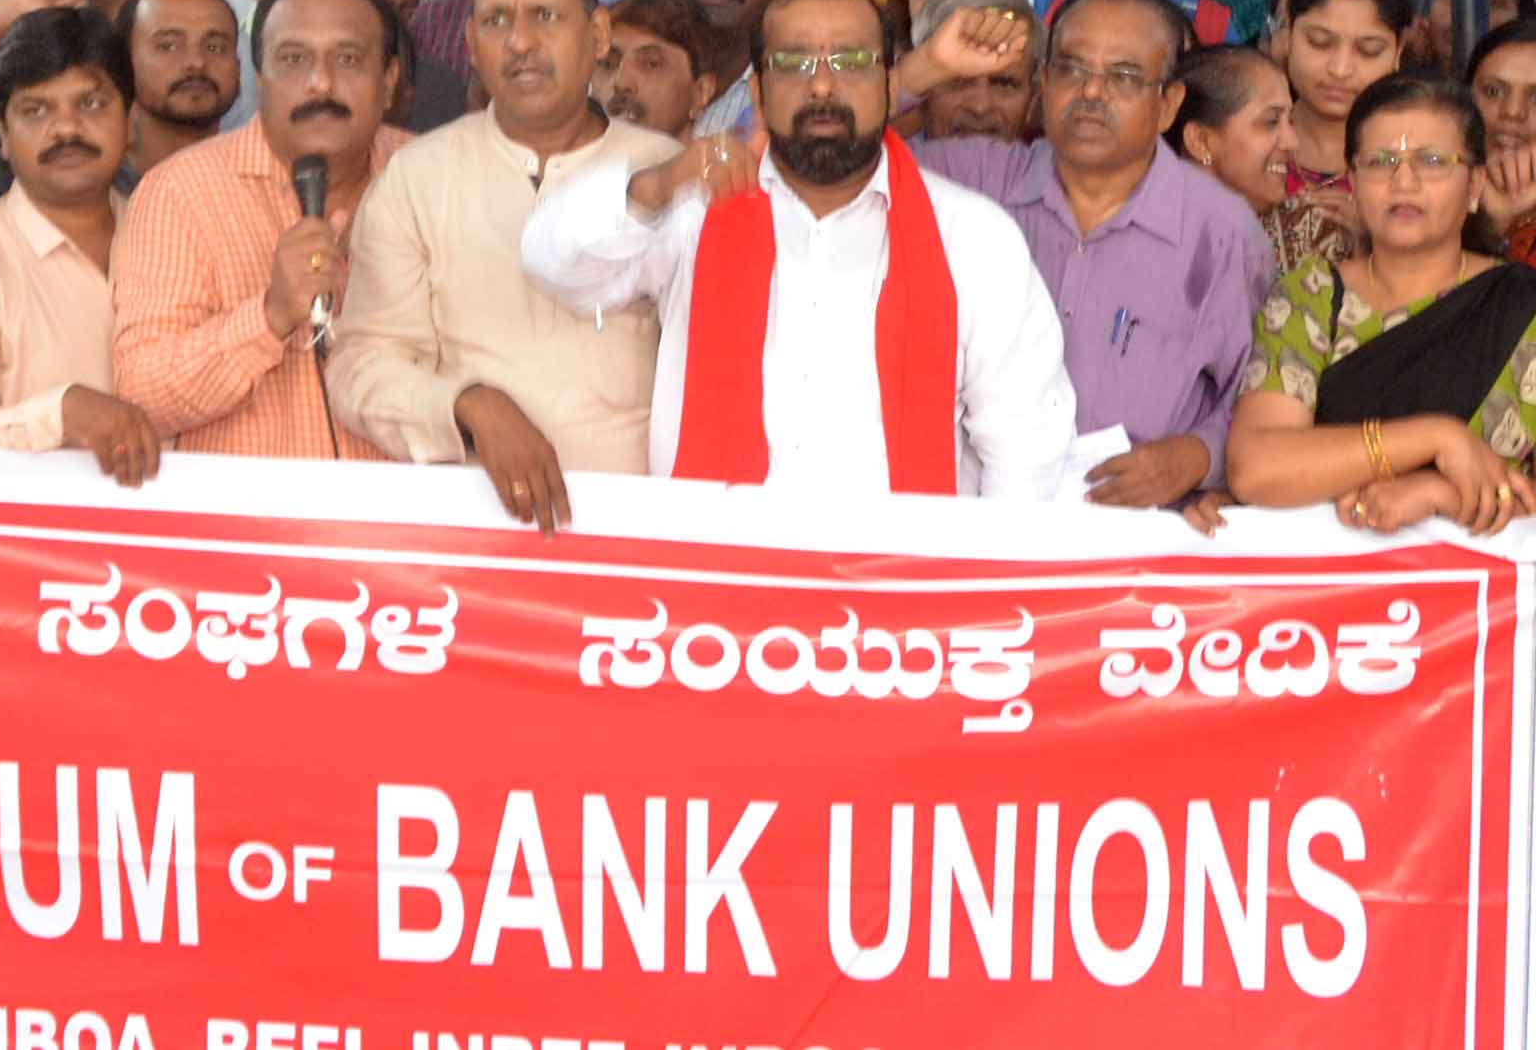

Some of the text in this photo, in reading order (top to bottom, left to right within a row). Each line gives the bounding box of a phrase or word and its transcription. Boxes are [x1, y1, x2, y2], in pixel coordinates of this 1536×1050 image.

[37, 562, 460, 680] ಸಂಘಗಳ
[578, 600, 1042, 735] ಸಂಯುಕ್ತ
[1099, 595, 1424, 701] ವೇದಿಕೆ
[227, 841, 336, 904] OF
[375, 782, 778, 978] BANK
[827, 795, 1369, 999] UNIONS
